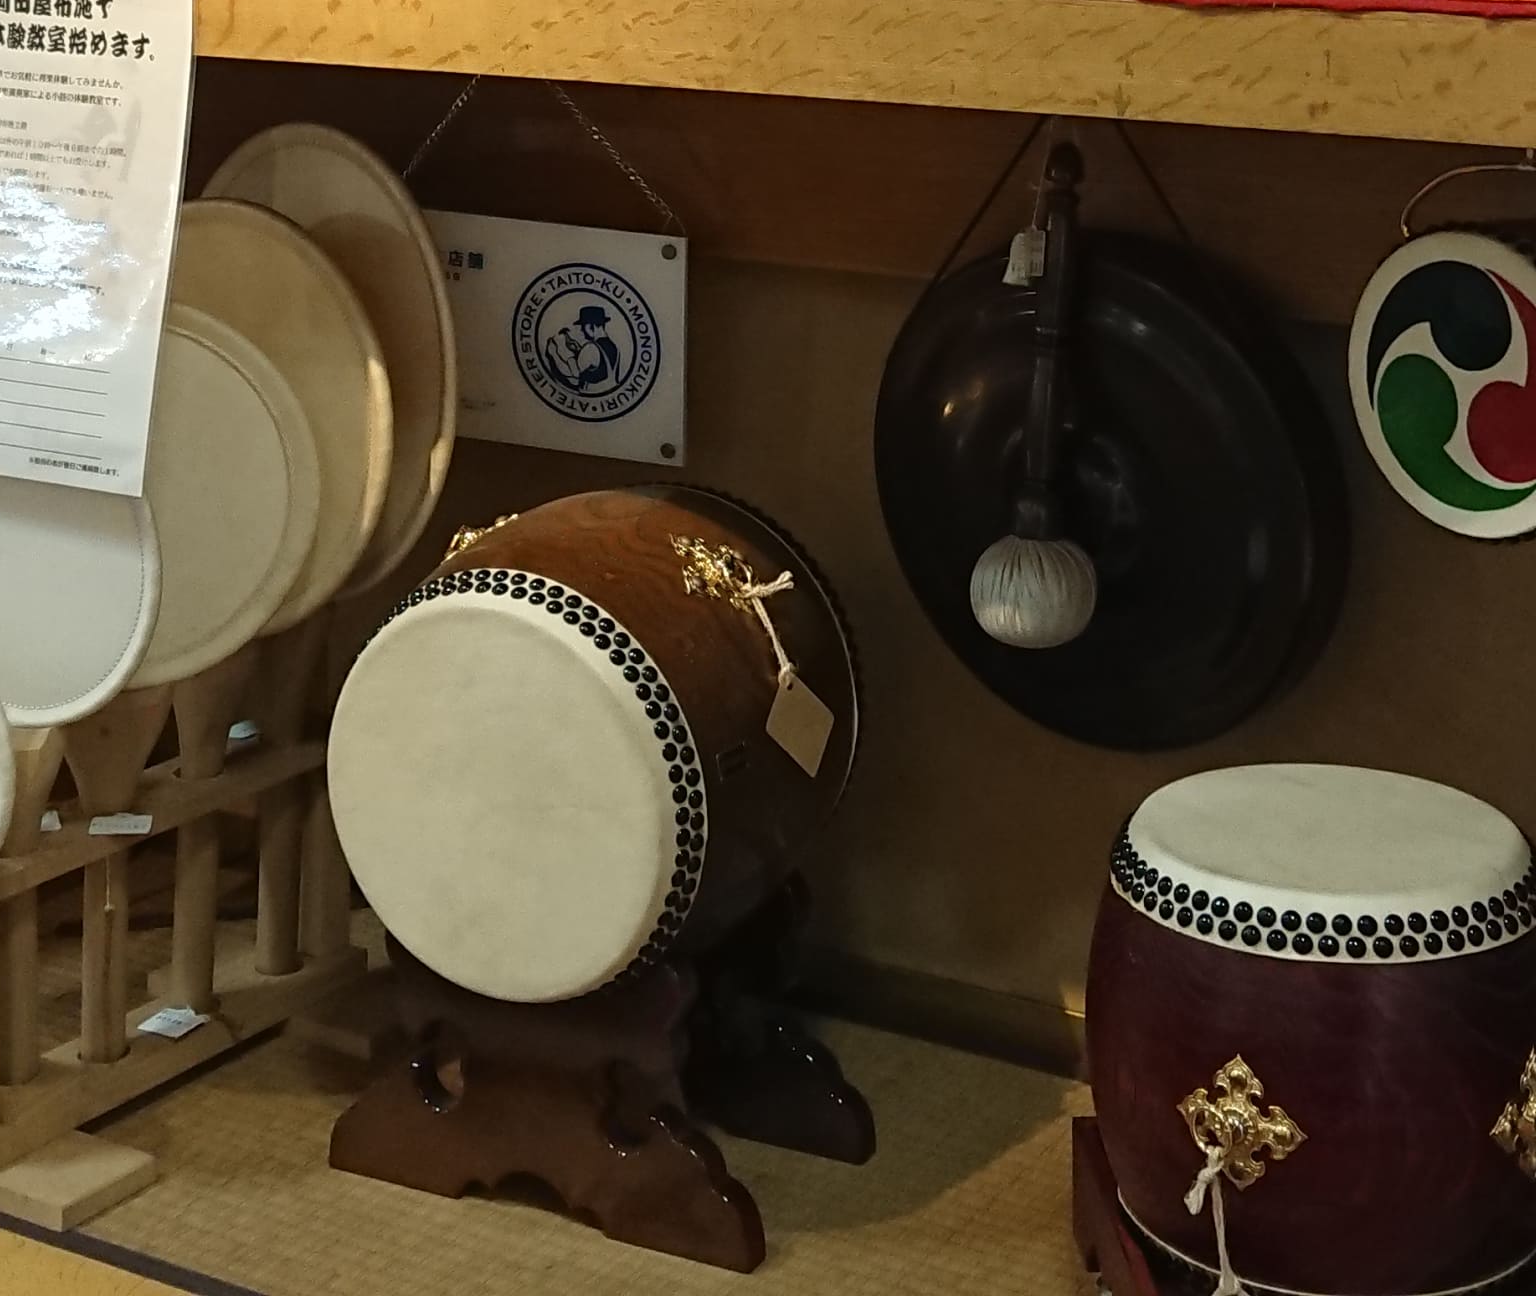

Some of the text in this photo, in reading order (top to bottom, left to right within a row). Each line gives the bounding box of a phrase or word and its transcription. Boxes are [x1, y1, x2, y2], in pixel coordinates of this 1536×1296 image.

[545, 271, 626, 299] TAITO-KU
[520, 292, 590, 413] ATELIER STORE
[600, 305, 653, 413] MONOZUKURI
